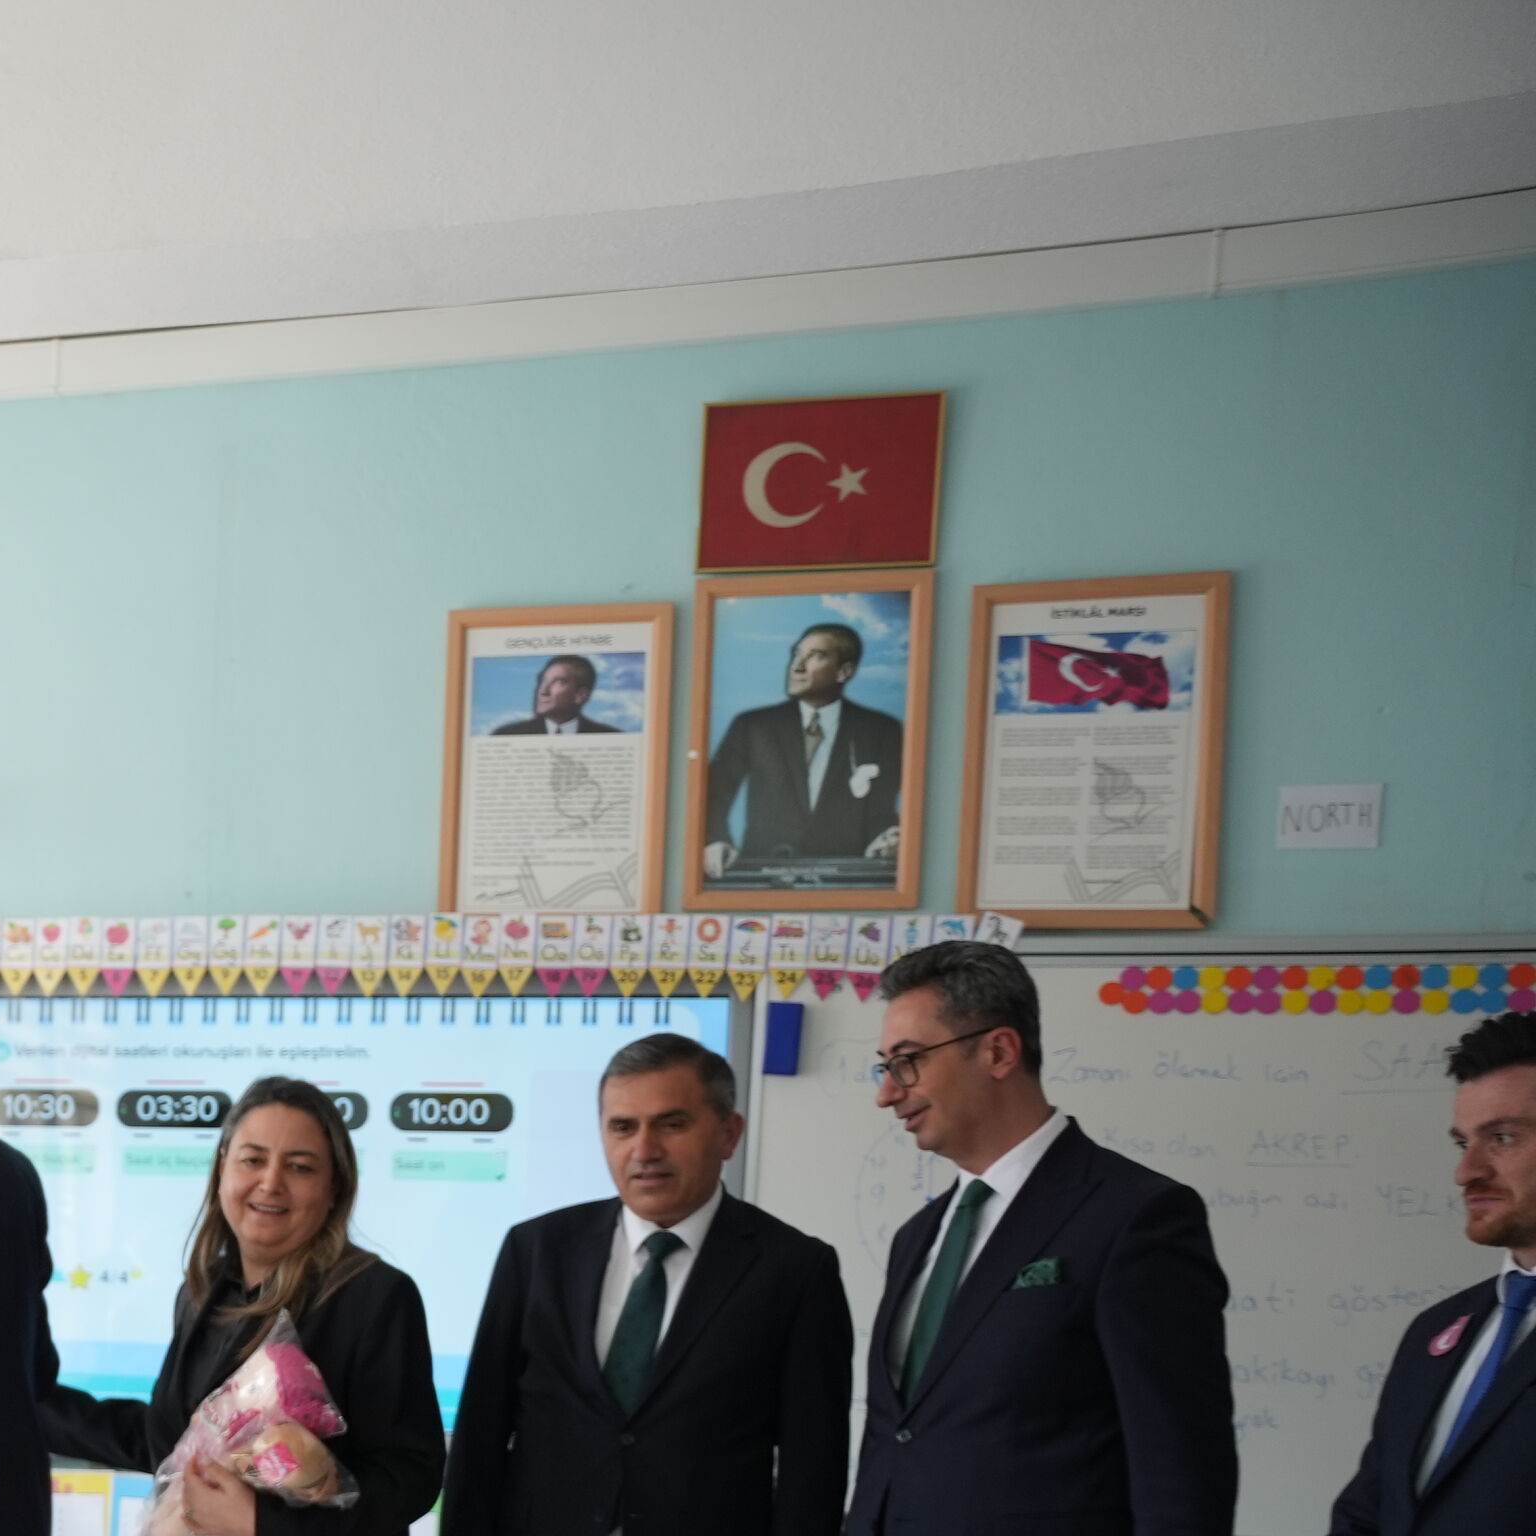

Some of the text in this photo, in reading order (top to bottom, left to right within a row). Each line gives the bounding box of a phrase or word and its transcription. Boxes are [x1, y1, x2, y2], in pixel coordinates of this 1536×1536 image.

[1280, 801, 1373, 836] NORTH
[1352, 1039, 1449, 1083] SAA
[1, 1094, 77, 1121] 10:30
[135, 1094, 220, 1122] 03:30
[407, 1097, 491, 1125] 10:00
